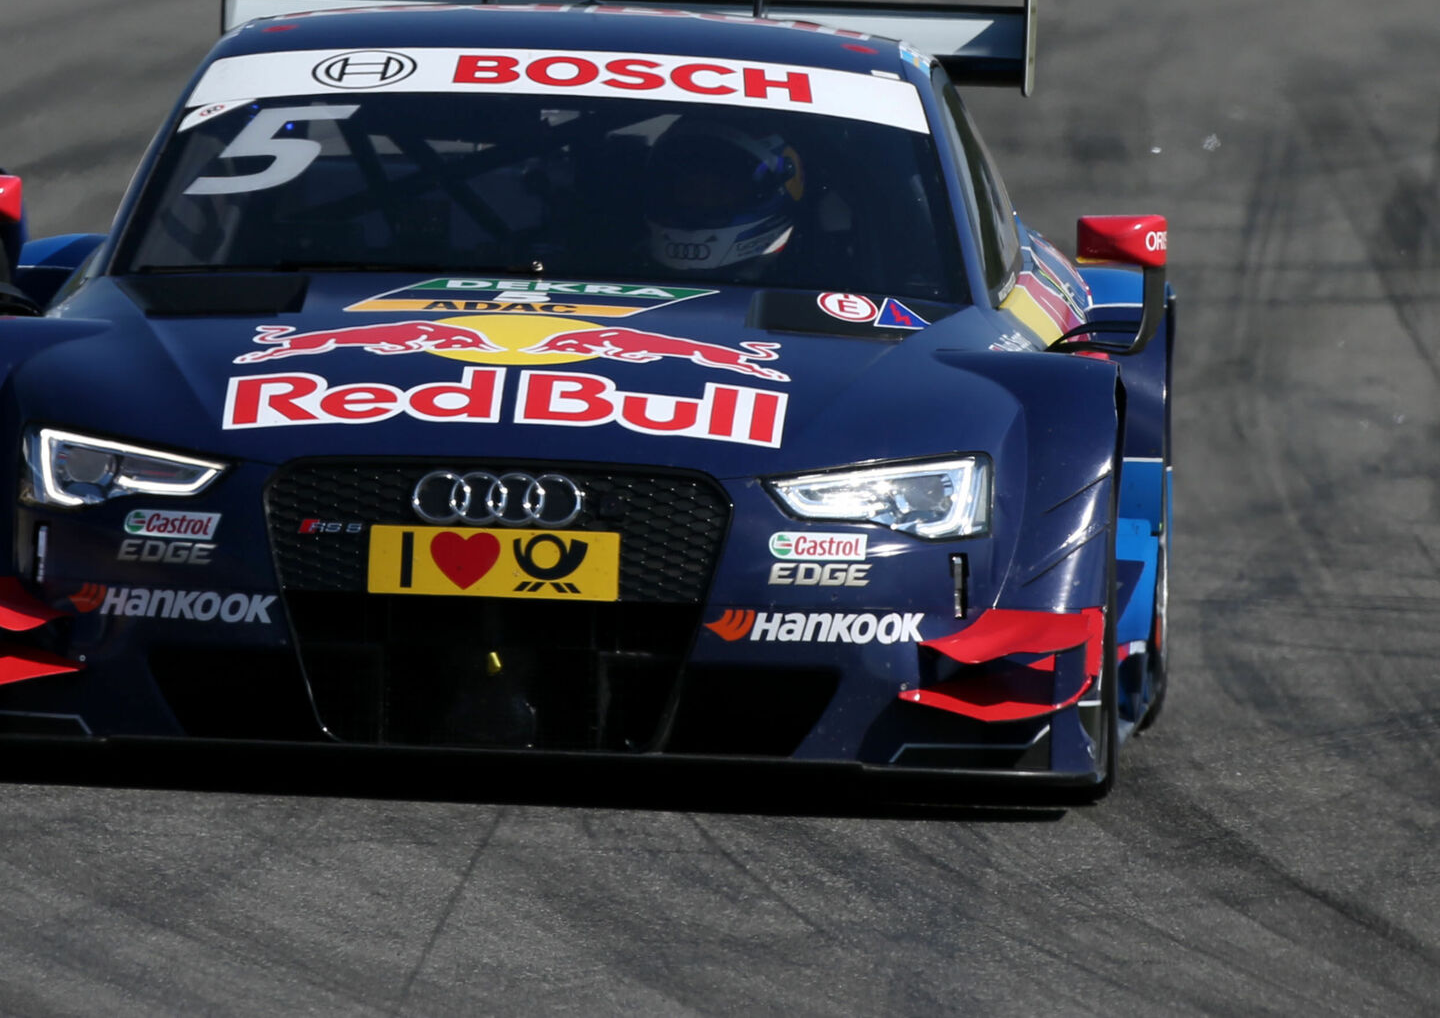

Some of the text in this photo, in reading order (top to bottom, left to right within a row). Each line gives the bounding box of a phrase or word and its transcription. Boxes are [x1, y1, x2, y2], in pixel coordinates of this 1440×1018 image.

[452, 54, 814, 104] BOSCH
[183, 105, 360, 195] 5
[446, 279, 677, 298] DEKRA
[492, 290, 552, 304] 5
[422, 300, 579, 314] ADAC
[223, 366, 788, 448] Red Bull
[145, 513, 214, 536] Castrol
[116, 538, 219, 565] EDGE
[793, 534, 862, 557] Castrol
[768, 562, 874, 587] EDGE
